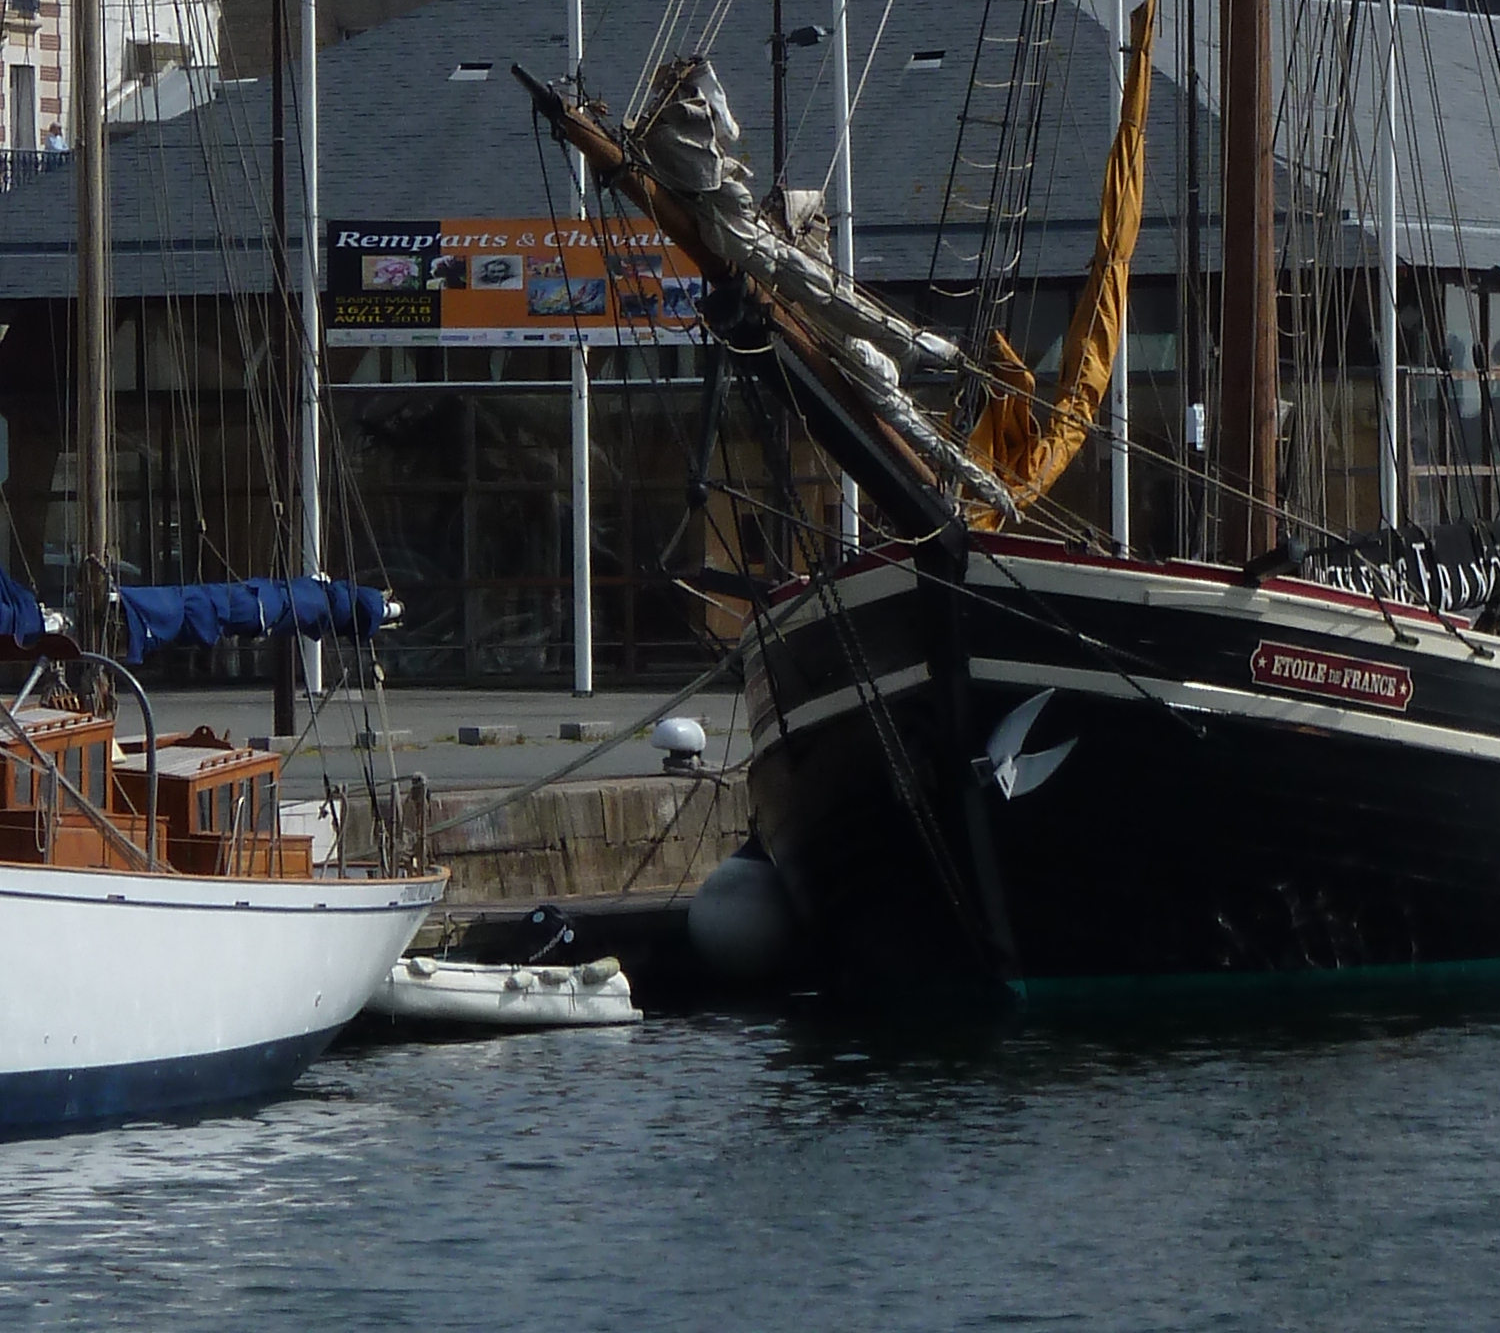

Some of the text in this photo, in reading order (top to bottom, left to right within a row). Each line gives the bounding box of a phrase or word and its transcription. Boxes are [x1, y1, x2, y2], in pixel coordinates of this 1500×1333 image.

[335, 231, 508, 252] Remp'arts
[515, 232, 536, 247] &
[336, 305, 431, 315] 16/17/18
[334, 315, 431, 324] AVRIL 2010
[1271, 654, 1327, 684] ETOILE
[1342, 667, 1397, 697] FRANCE
